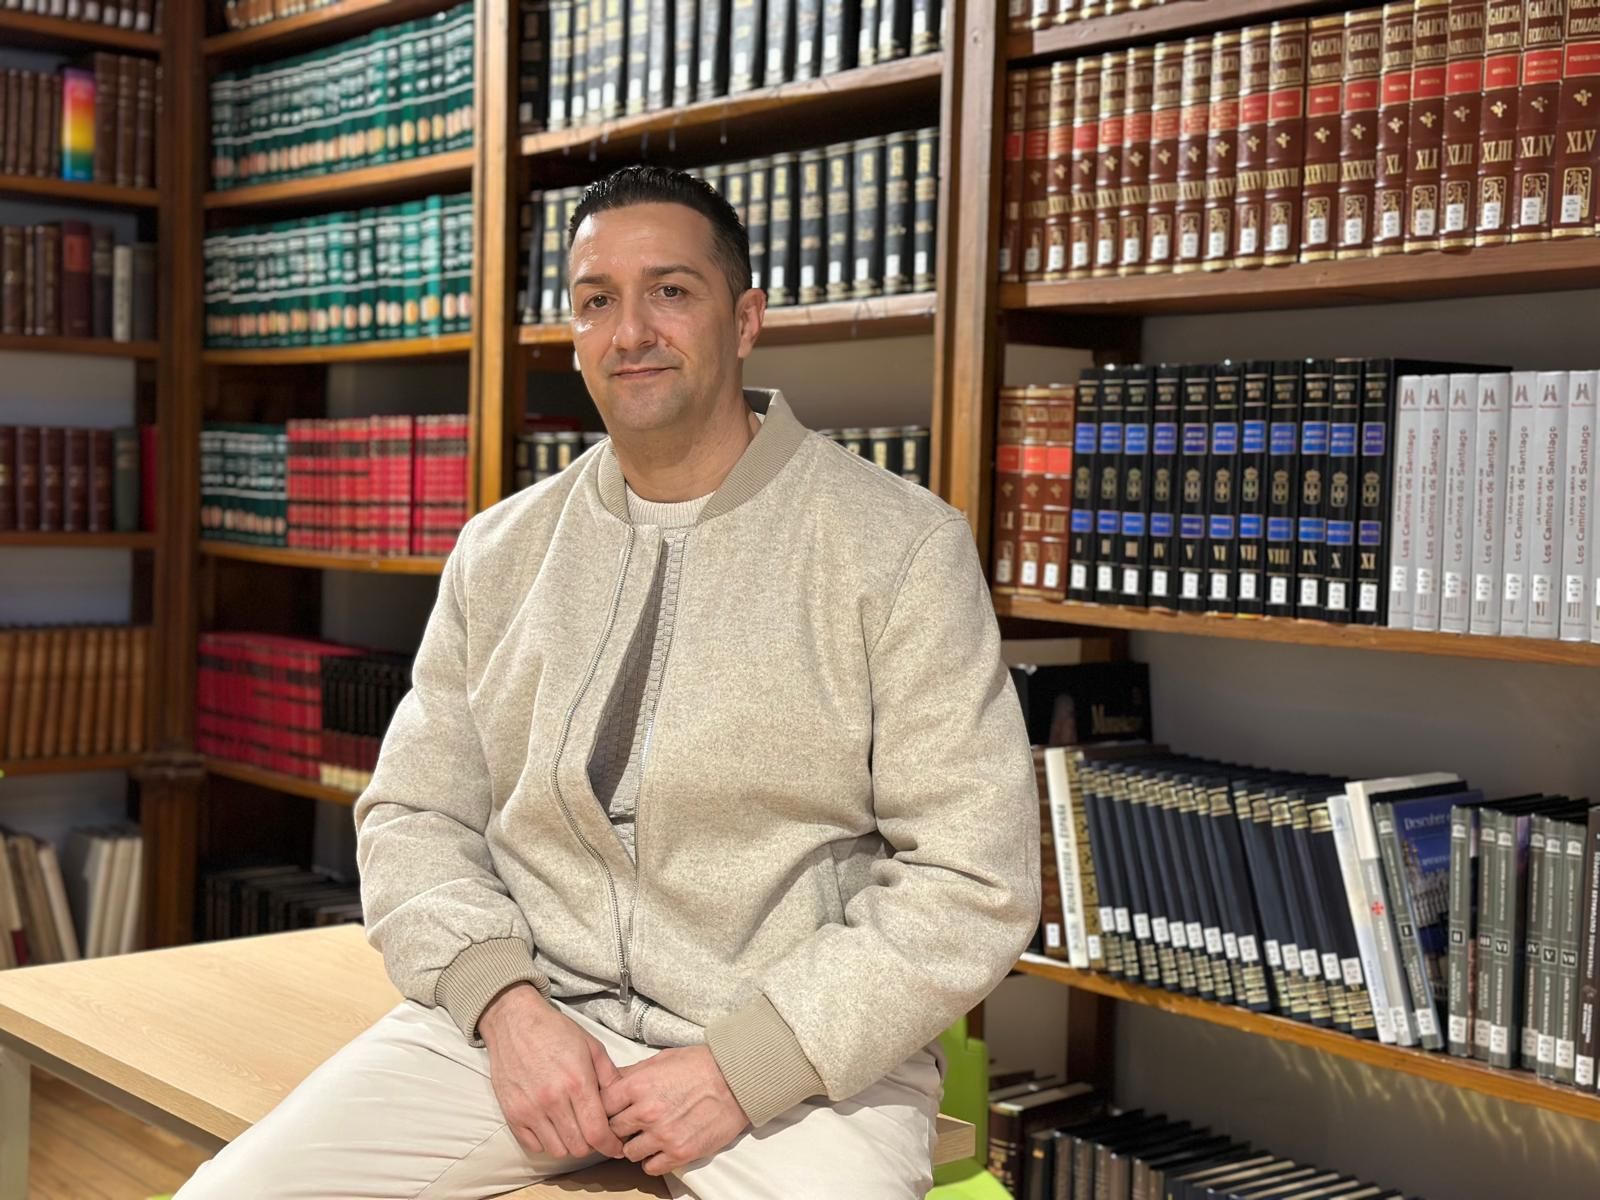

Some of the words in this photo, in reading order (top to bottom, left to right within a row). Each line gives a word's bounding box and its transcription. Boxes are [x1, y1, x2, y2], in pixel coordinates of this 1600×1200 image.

[1487, 4, 1520, 26] GALICIA
[1482, 140, 1513, 164] XLIII
[1520, 135, 1556, 158] XLIV
[1566, 129, 1596, 154] XLV
[1386, 154, 1402, 176] XL
[1416, 148, 1439, 170] XLI
[1447, 144, 1474, 166] XLII
[1406, 428, 1416, 474] Santiago
[1429, 428, 1440, 475] Santiago
[1457, 429, 1467, 476] Santiago
[1487, 430, 1497, 477] Santiago
[1518, 426, 1528, 474] Santiago
[1546, 426, 1558, 475] Santiago
[1579, 425, 1590, 474] Santiago
[1405, 479, 1412, 490] de
[1429, 479, 1436, 490] de
[1456, 480, 1464, 492] de
[1486, 481, 1494, 493] de
[1517, 478, 1525, 490] de
[1546, 479, 1554, 491] de
[1579, 479, 1586, 491] de
[1402, 494, 1412, 536] Caminos
[1426, 495, 1436, 537] Caminos
[1455, 496, 1464, 539] Caminos
[1484, 497, 1494, 541] Caminos
[1514, 495, 1524, 539] Caminos
[1543, 496, 1553, 540] Caminos
[1576, 496, 1586, 541] Caminos
[1186, 544, 1194, 560] V
[1213, 544, 1226, 562] VI
[1240, 544, 1258, 561] VII
[1268, 548, 1290, 565] VIII
[1302, 549, 1318, 566] IX
[1332, 552, 1342, 570] X
[1360, 552, 1376, 570] XI
[1425, 541, 1434, 560] Los
[1543, 545, 1551, 564] Los
[1576, 545, 1584, 564] Los
[1592, 851, 1600, 888] EUROPEOS
[1589, 890, 1598, 933] CULTURALES
[1496, 940, 1508, 950] VI
[1544, 951, 1554, 960] V
[1586, 934, 1596, 978] ITINERARIOS
